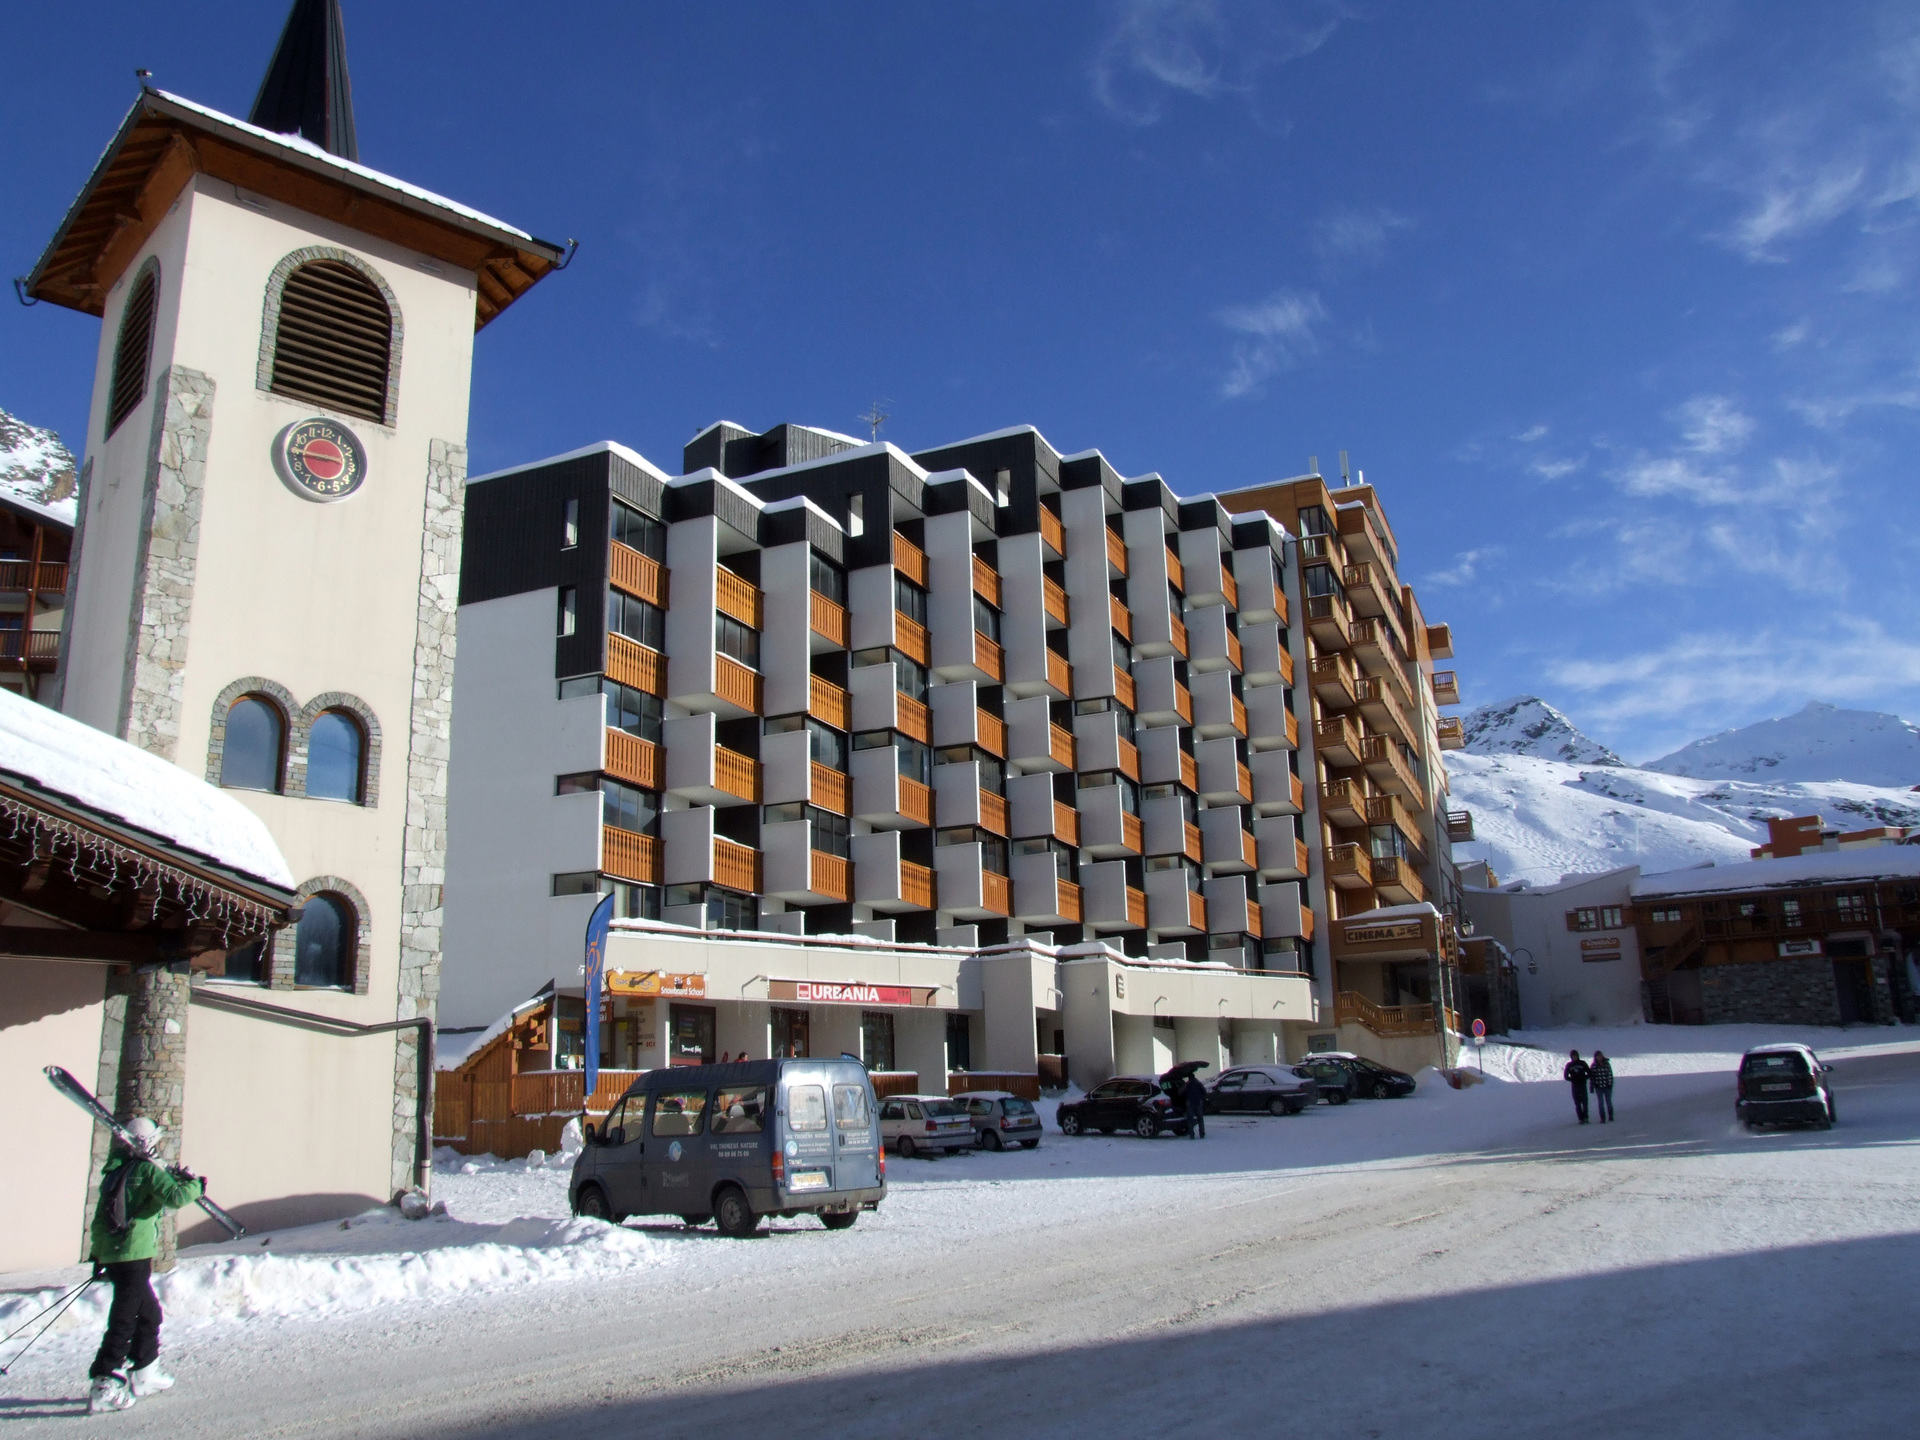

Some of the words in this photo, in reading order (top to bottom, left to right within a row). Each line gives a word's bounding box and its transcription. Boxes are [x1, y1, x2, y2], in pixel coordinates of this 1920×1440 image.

[321, 427, 332, 438] 12
[1348, 929, 1394, 941] CINEMA
[661, 986, 688, 995] Snowboard
[688, 987, 704, 996] School
[812, 985, 879, 1001] URBANIA
